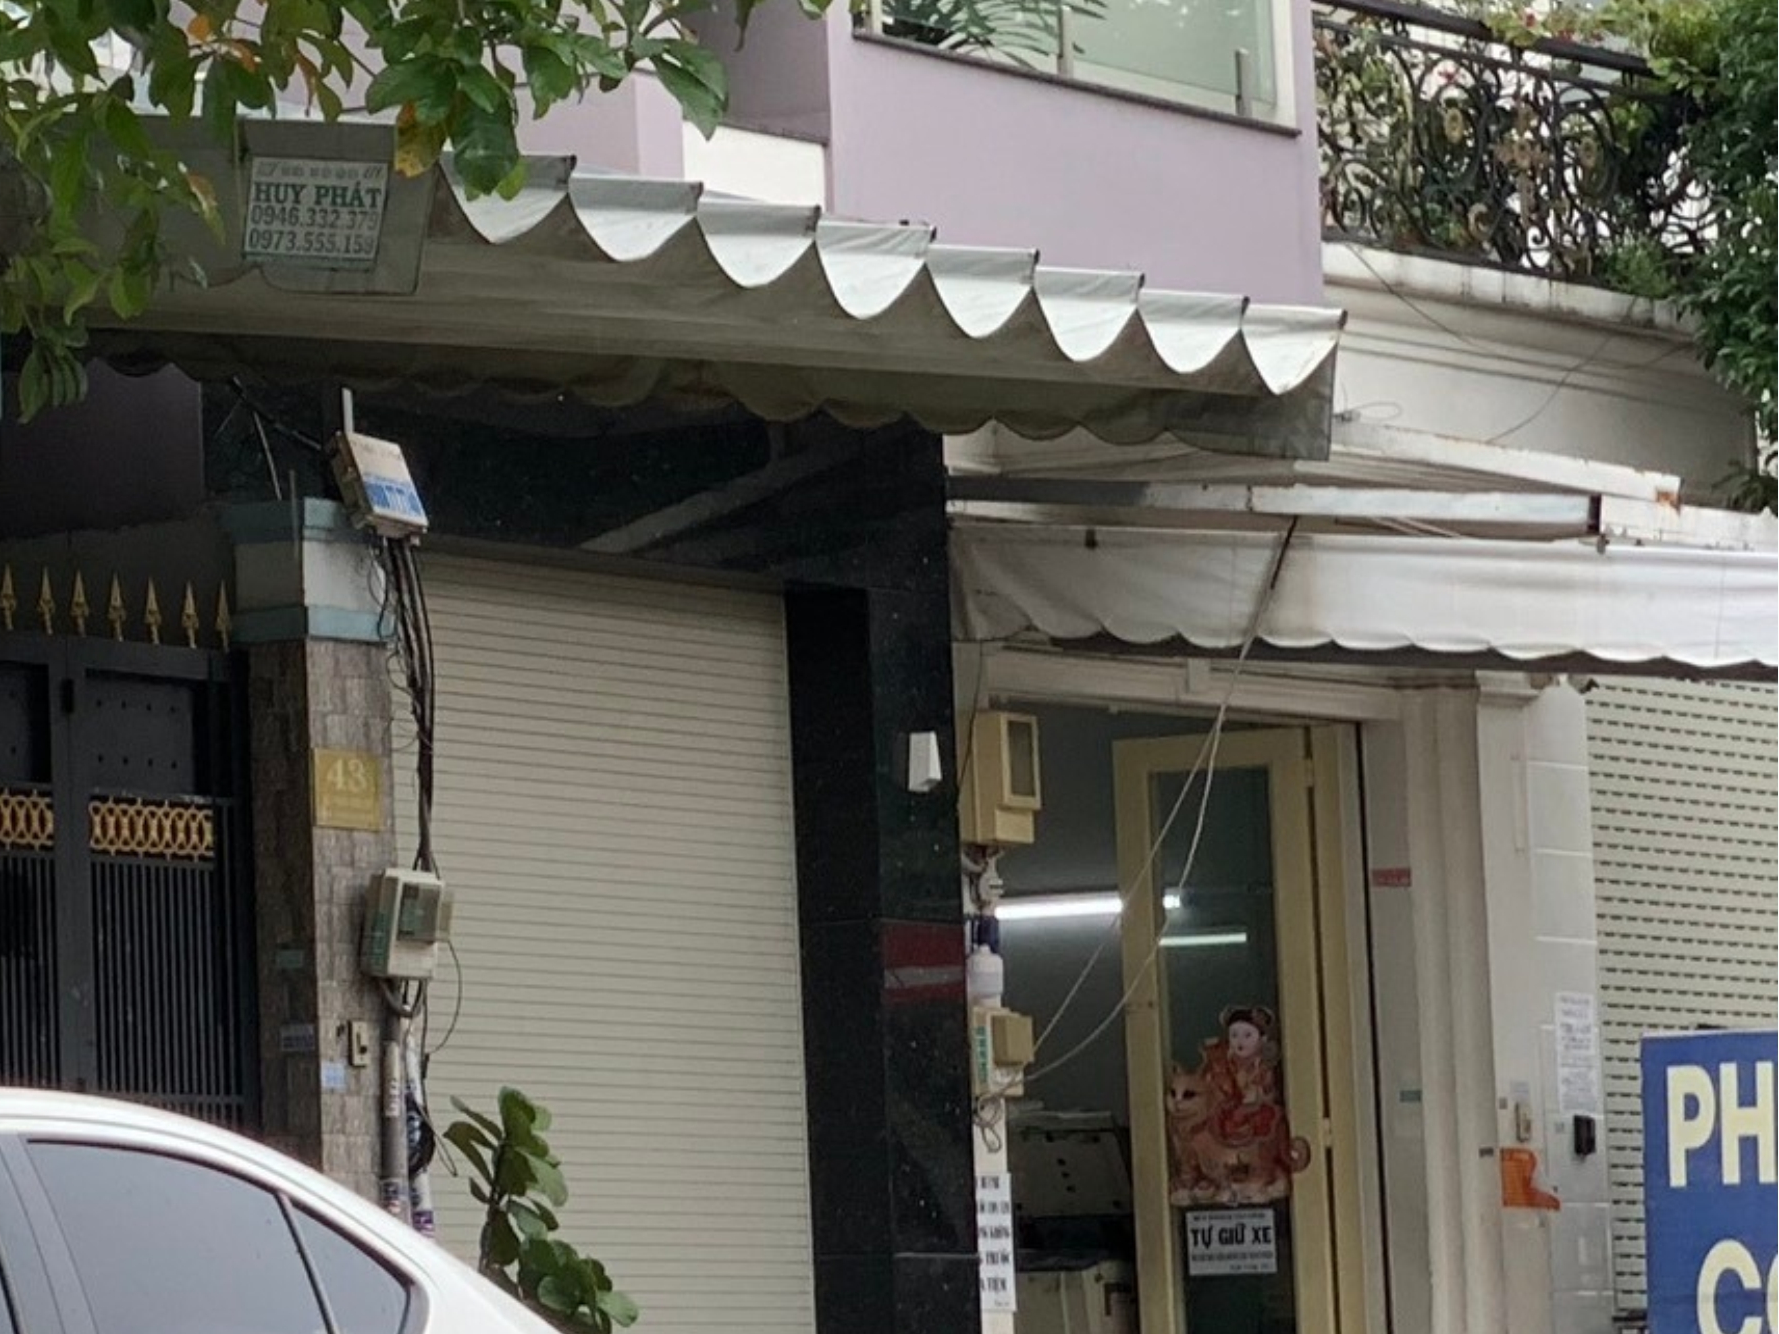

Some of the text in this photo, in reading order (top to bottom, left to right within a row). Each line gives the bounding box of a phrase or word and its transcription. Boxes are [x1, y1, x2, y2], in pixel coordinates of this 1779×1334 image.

[254, 180, 382, 208] HUY PHÁT
[1252, 1226, 1272, 1245] XE
